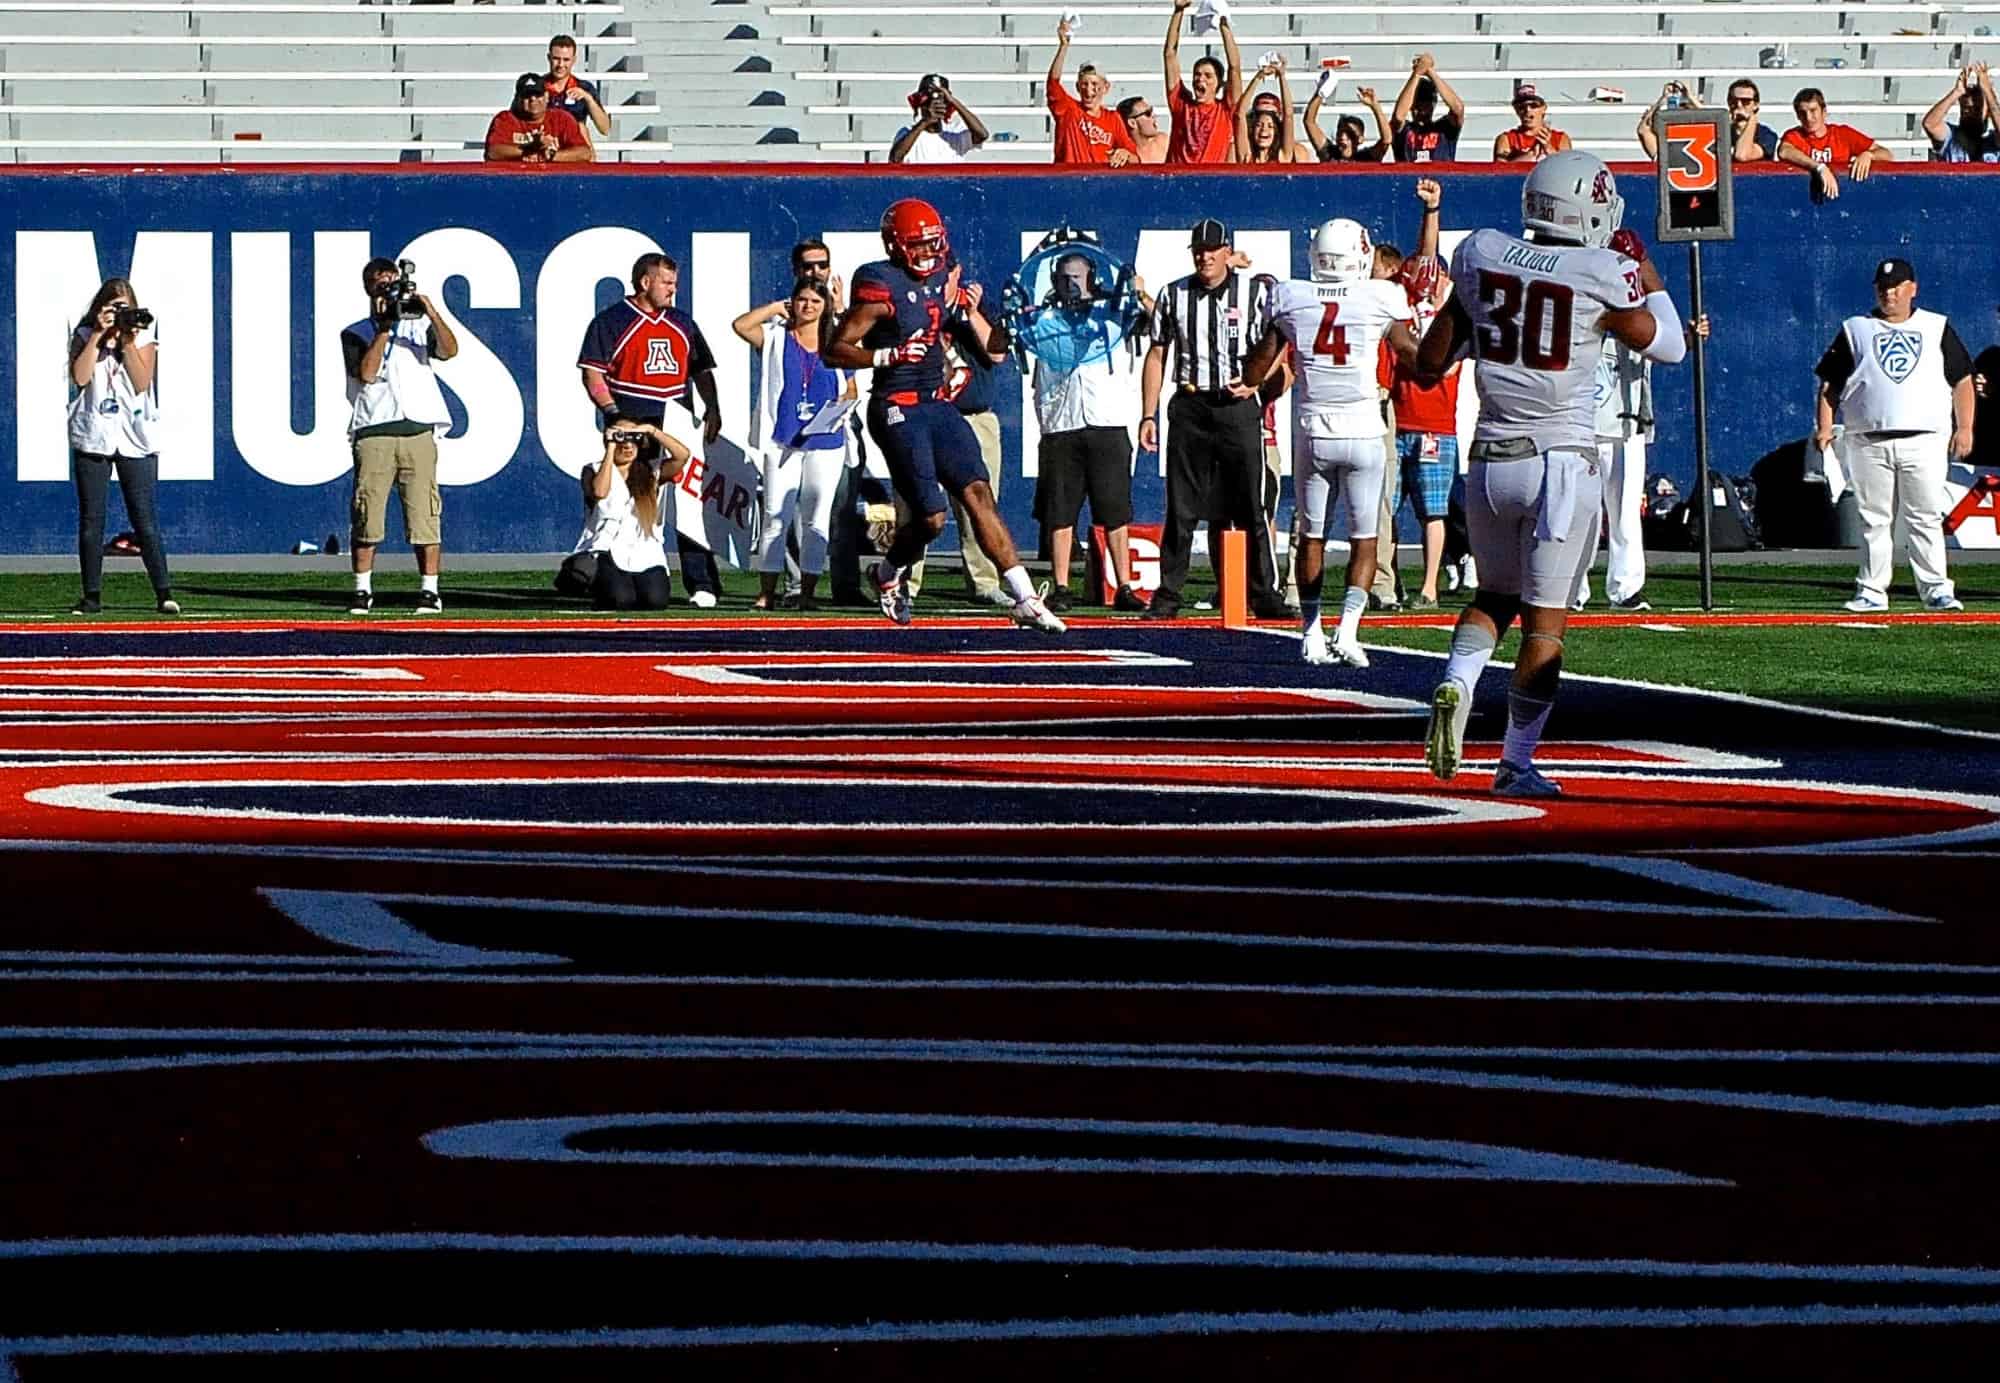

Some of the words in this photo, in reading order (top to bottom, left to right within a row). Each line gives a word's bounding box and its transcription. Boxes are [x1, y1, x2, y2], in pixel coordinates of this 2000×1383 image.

[1667, 123, 1717, 191] 3
[1312, 301, 1351, 366] 4
[1475, 267, 1575, 372] 30
[644, 338, 679, 375] A
[1889, 357, 1908, 372] 12
[1104, 537, 1161, 592] G
